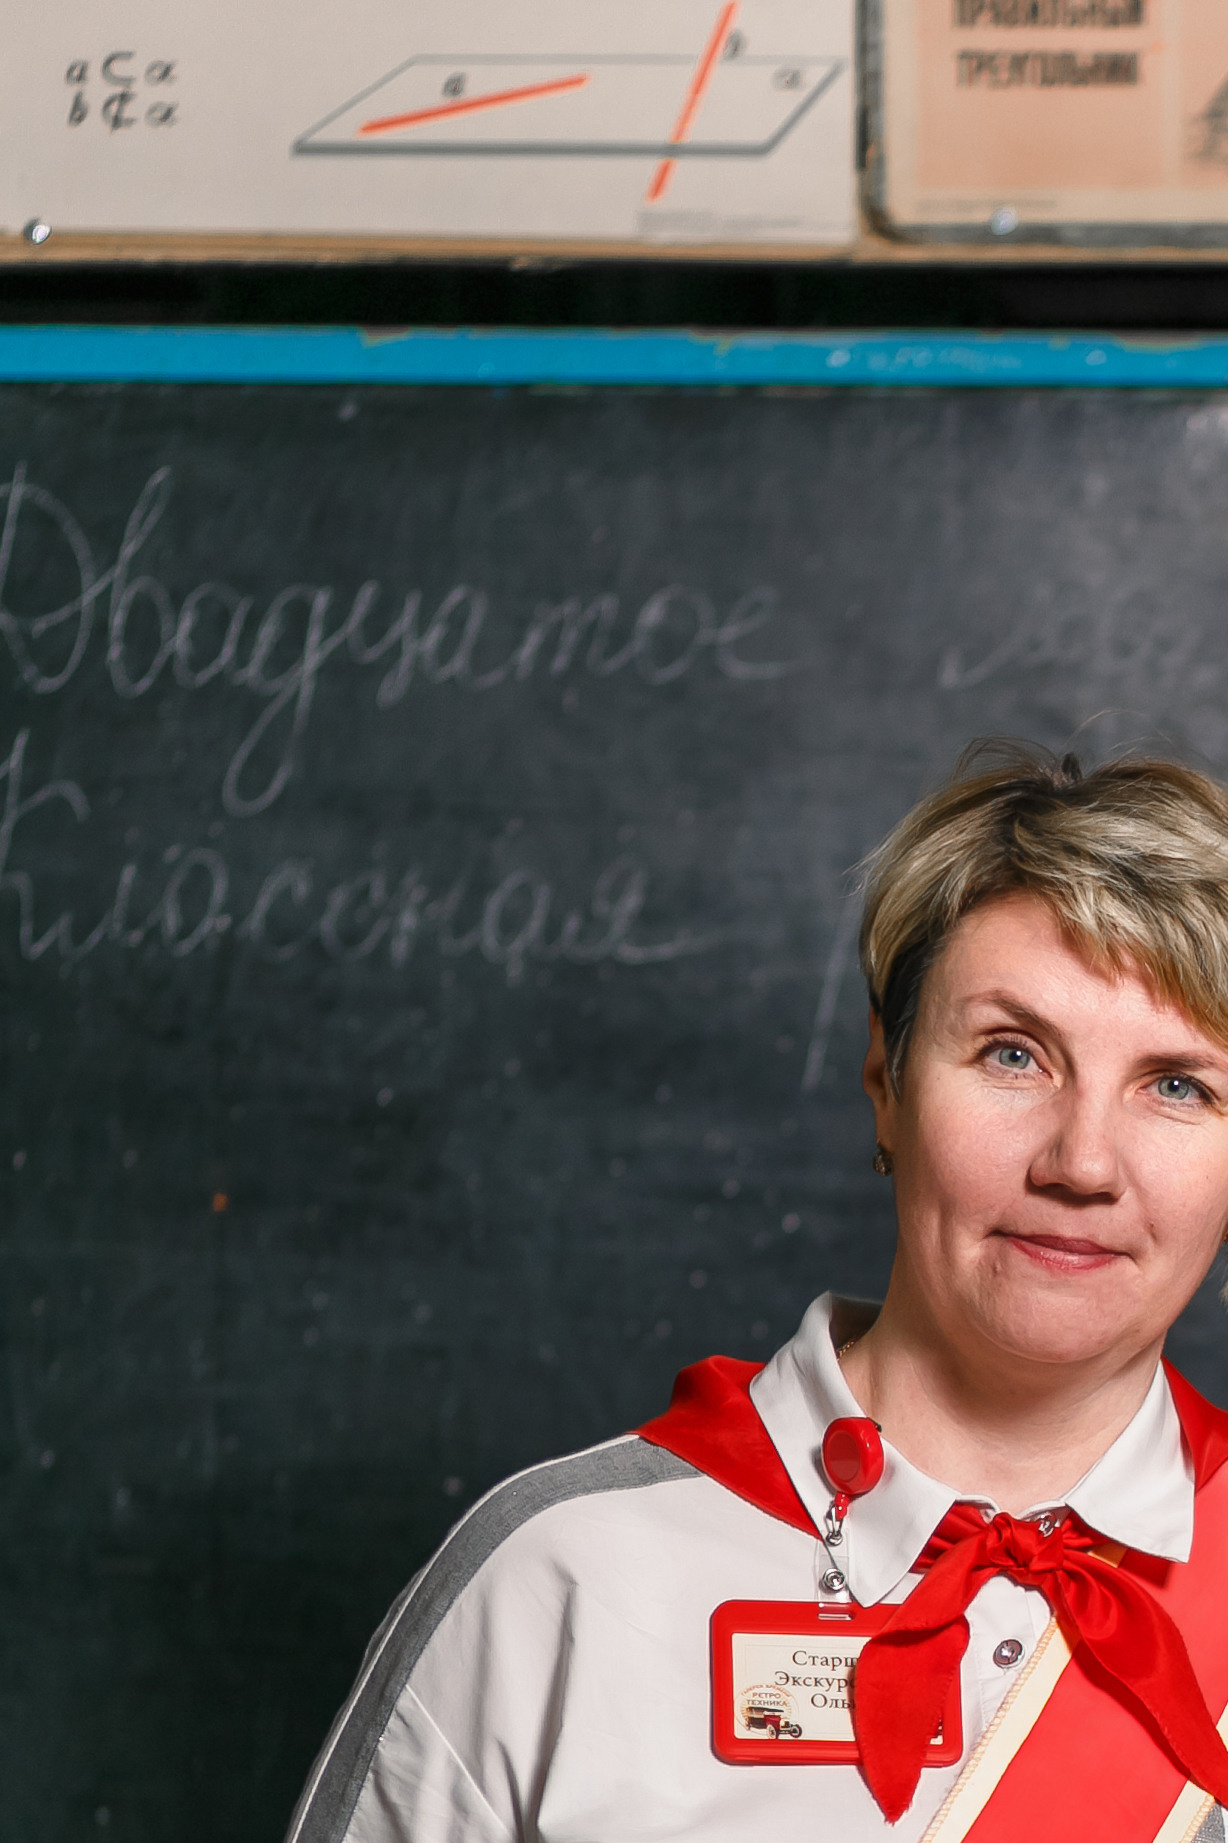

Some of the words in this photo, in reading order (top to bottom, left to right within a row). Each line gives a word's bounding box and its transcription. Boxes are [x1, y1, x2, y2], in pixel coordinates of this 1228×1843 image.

[791, 1650, 858, 1671] Старш
[774, 1670, 855, 1692] Экскур
[810, 1693, 856, 1709] Оль
